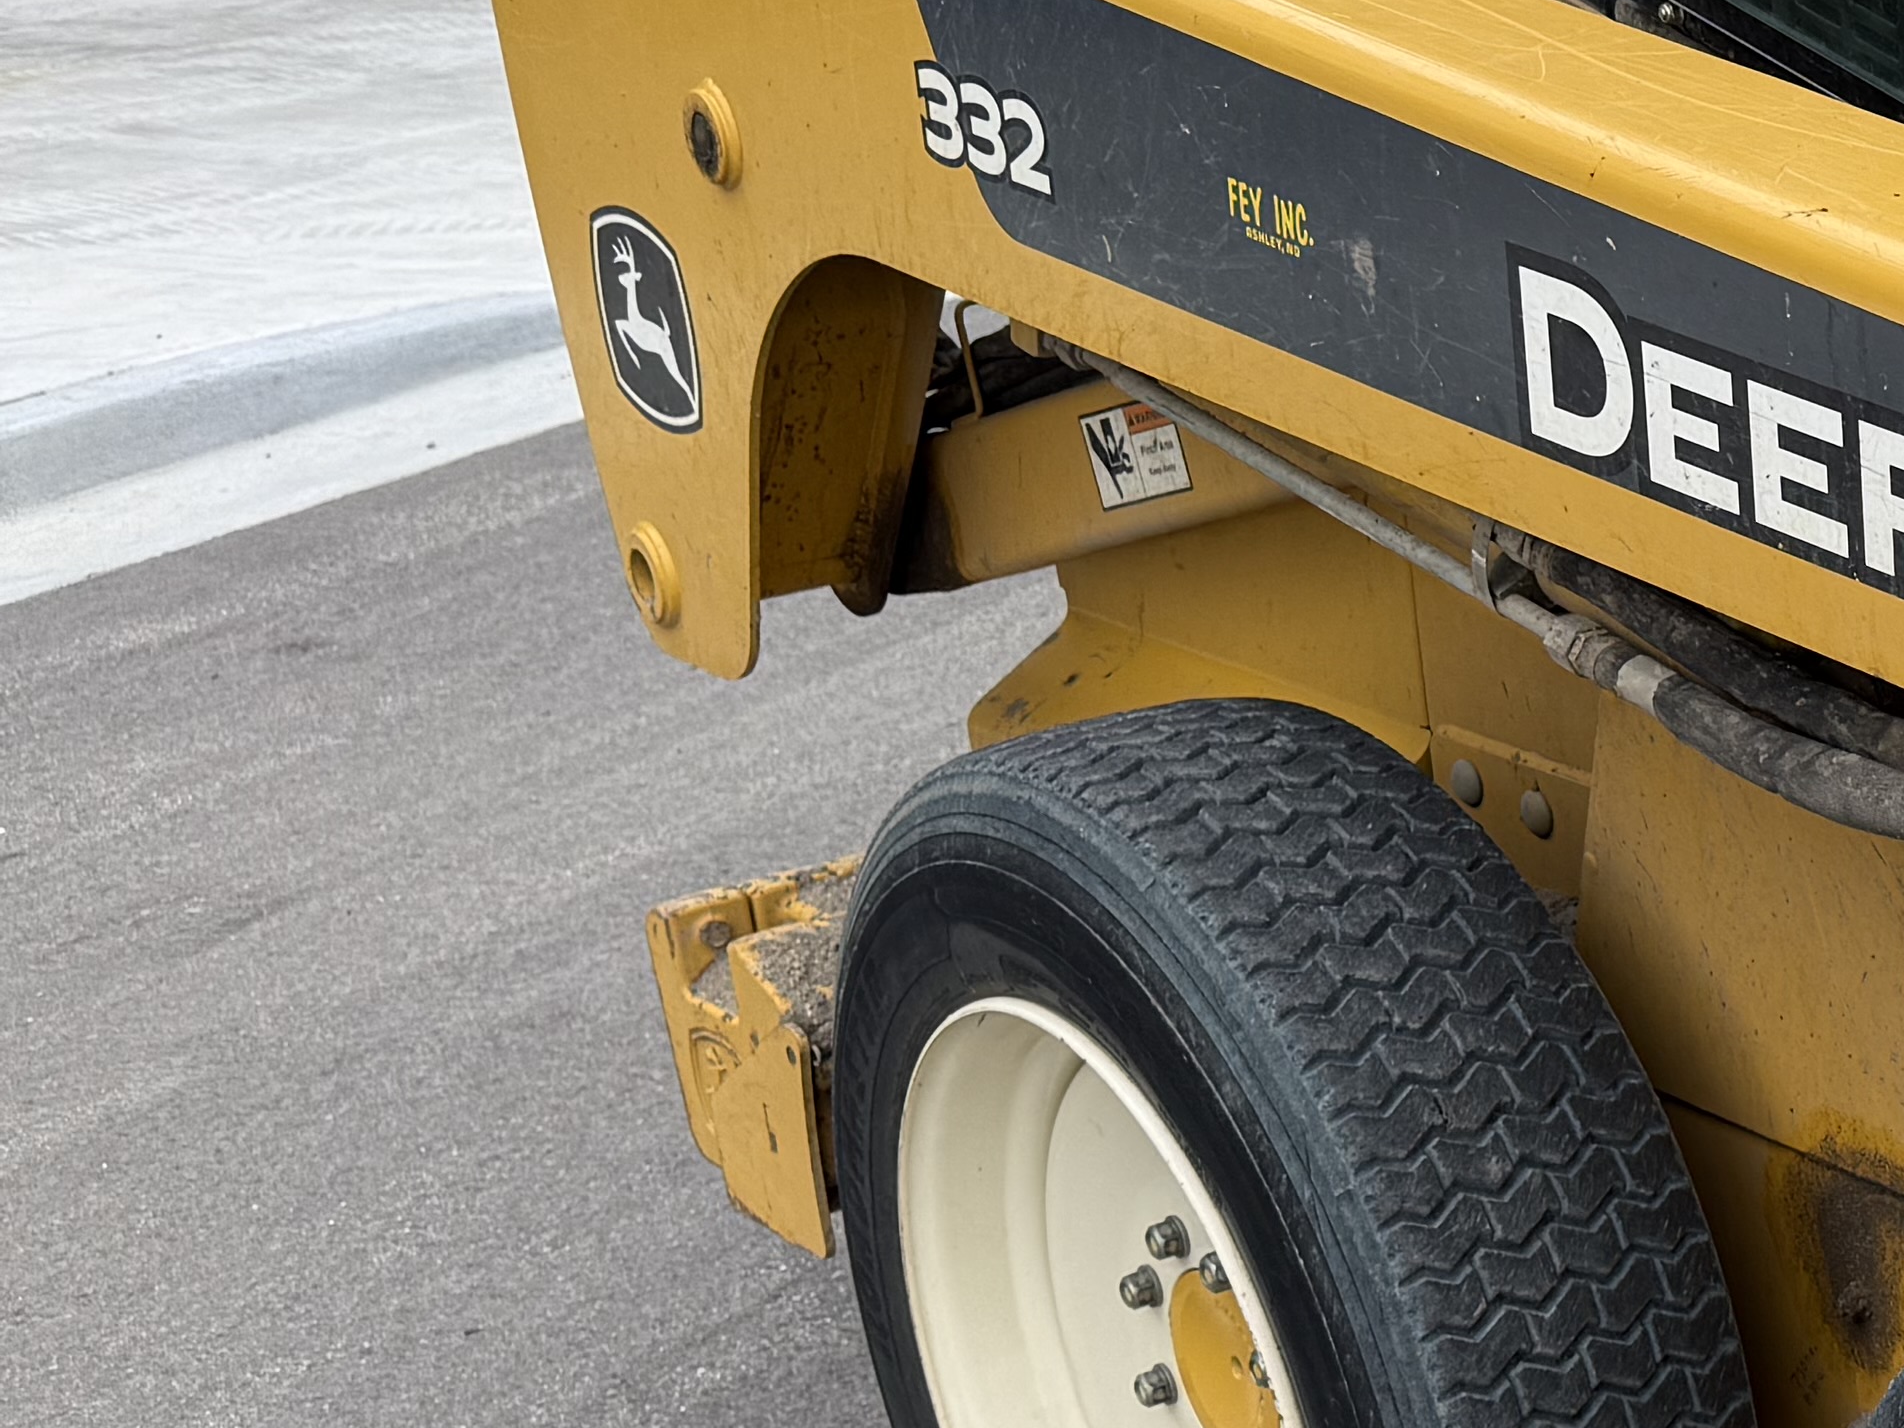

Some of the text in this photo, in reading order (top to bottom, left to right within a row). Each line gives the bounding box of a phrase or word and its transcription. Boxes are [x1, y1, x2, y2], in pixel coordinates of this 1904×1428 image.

[916, 67, 1052, 196] 332
[1227, 176, 1314, 247] FEY INC.
